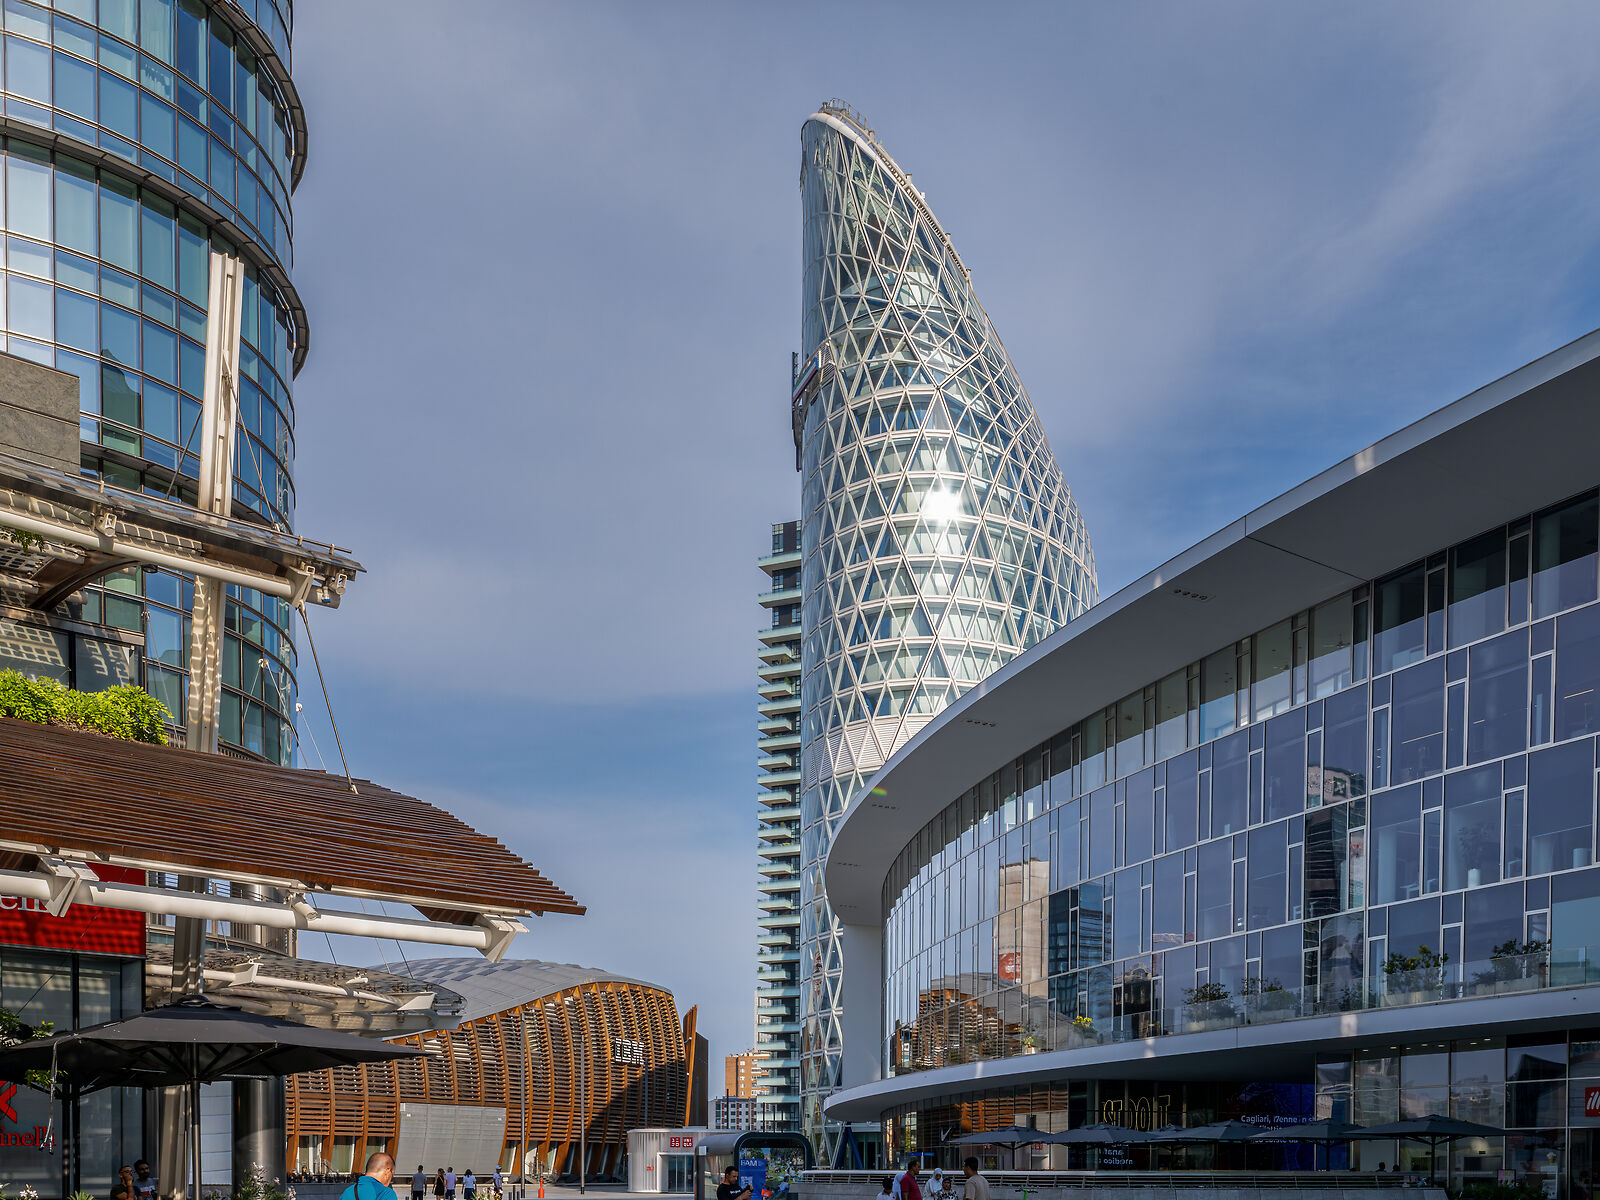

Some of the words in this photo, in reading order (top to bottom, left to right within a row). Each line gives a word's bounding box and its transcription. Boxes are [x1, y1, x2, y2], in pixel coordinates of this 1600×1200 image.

[615, 1037, 645, 1066] IBM
[1586, 1090, 1600, 1114] ill
[1240, 1114, 1271, 1125] Cagliari,
